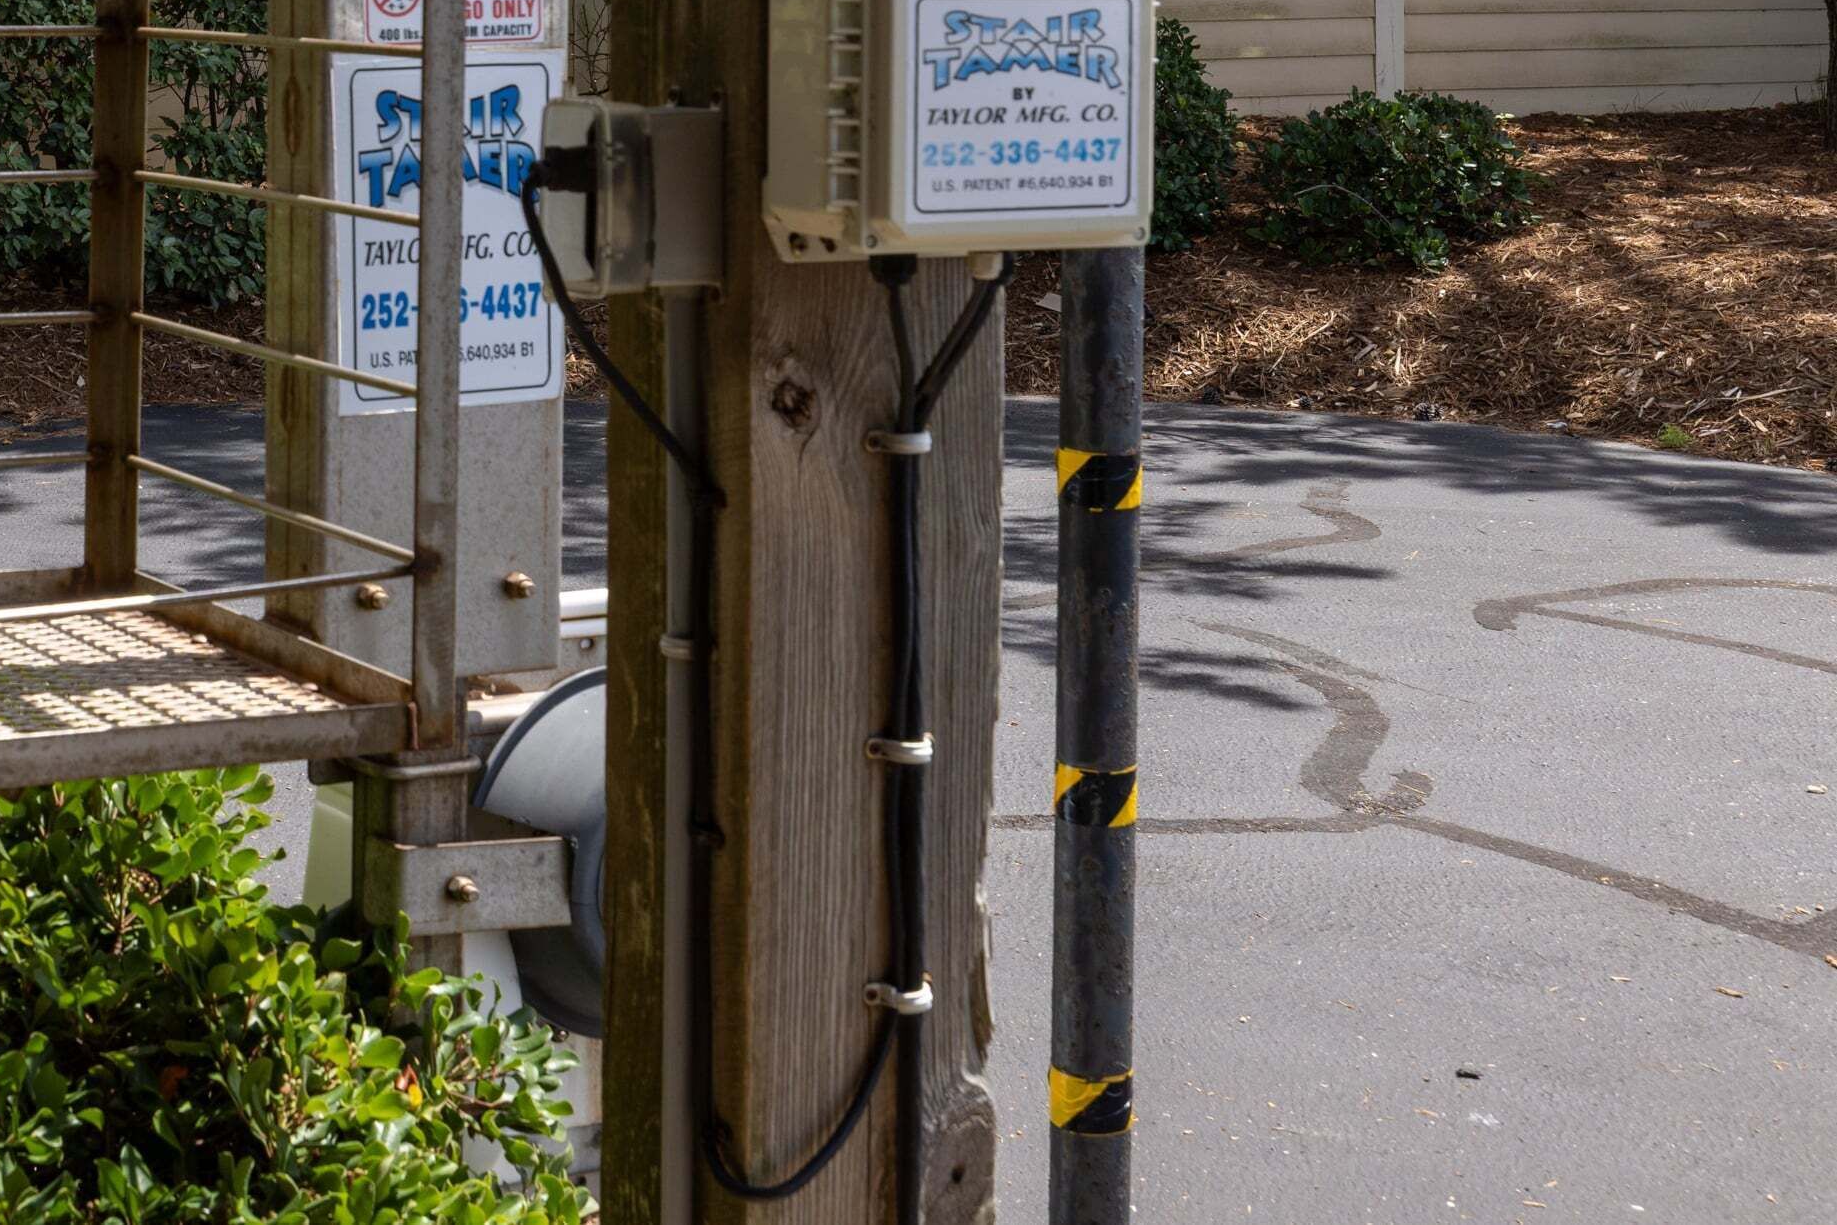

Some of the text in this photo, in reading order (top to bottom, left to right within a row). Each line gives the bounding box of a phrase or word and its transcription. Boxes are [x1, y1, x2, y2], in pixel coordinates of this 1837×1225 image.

[492, 0, 535, 19] ONLY
[379, 28, 400, 41] 400
[483, 23, 533, 37] CAPACITY
[944, 8, 1106, 45] STAIR
[923, 43, 1122, 91] TAMER
[1013, 87, 1034, 101] BY
[375, 84, 525, 144] STIR
[927, 103, 1119, 126] TAYLOR MFG. CO.
[923, 138, 1122, 167] 252-336-4437
[932, 179, 956, 193] U.S.
[963, 178, 1013, 191] PATENT
[1098, 175, 1114, 187] B1
[364, 237, 421, 266] TAYLO
[462, 232, 493, 260] FG.
[369, 351, 393, 368] U.S.
[520, 341, 535, 357] B1
